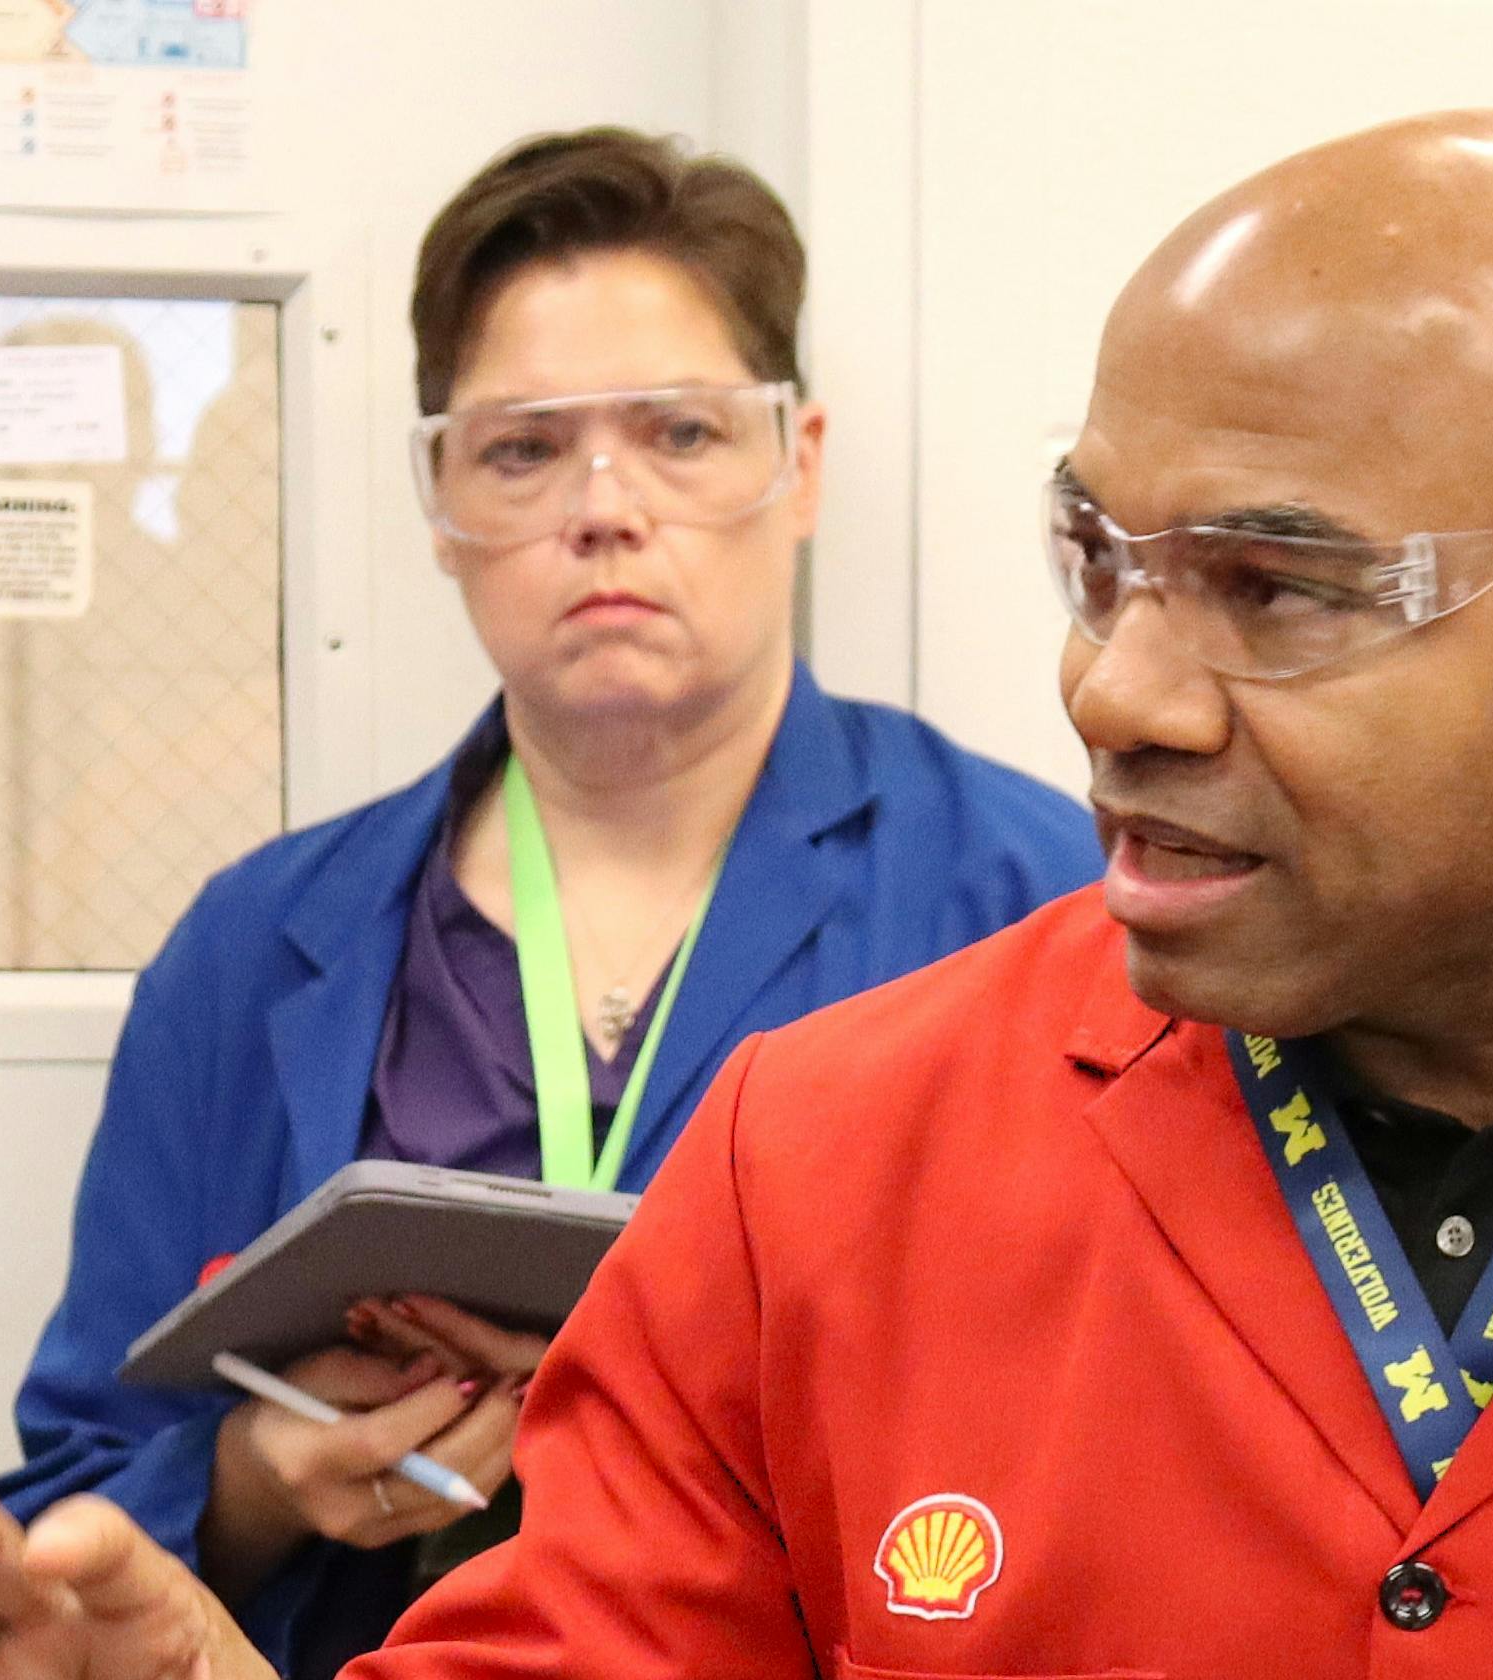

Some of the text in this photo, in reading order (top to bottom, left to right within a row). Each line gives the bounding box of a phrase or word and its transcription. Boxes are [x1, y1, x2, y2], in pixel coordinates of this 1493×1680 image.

[1268, 1090, 1327, 1168] M
[1311, 1180, 1400, 1333] WOLVERINES
[1383, 1348, 1450, 1423] M
